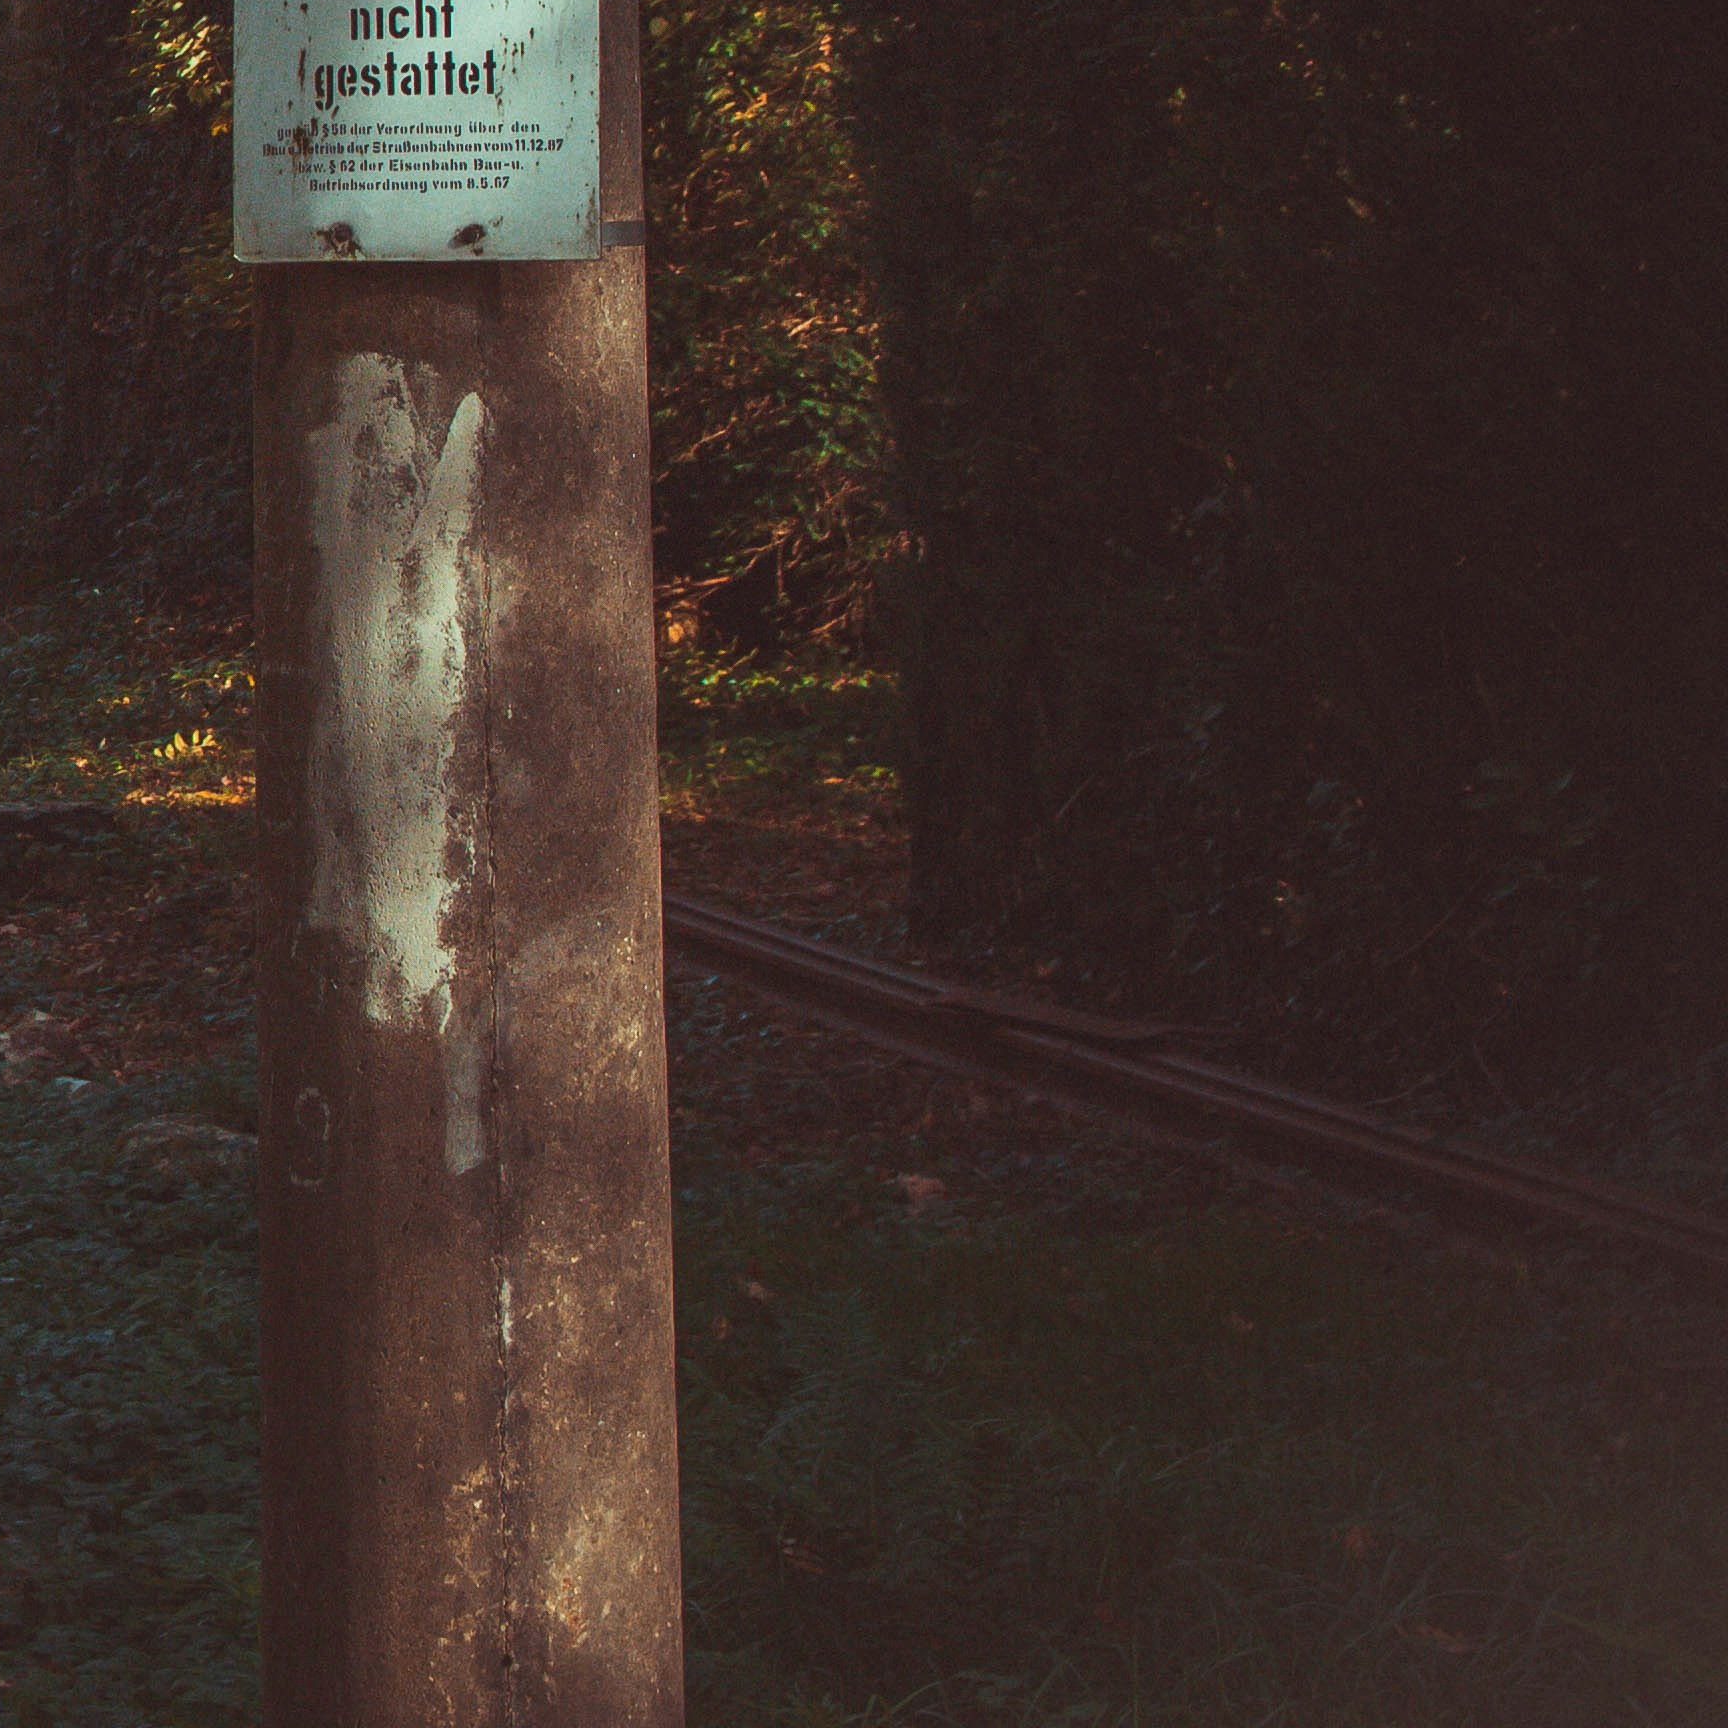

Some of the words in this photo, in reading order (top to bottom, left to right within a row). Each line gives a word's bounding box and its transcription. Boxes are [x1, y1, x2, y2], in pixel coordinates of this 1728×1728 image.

[314, 48, 498, 112] gestattet
[349, 123, 373, 136] der
[375, 122, 462, 138] Verordnung
[468, 121, 505, 135] über
[510, 120, 542, 134] den
[346, 141, 371, 154] der
[372, 140, 482, 154] Straßenbahnen
[484, 141, 513, 152] vom
[328, 160, 337, 175] §
[339, 160, 356, 173] 62
[359, 159, 385, 172] der
[388, 158, 468, 172] Eisenbahn
[309, 179, 428, 194] Betriebsordnung
[431, 180, 463, 190] vom
